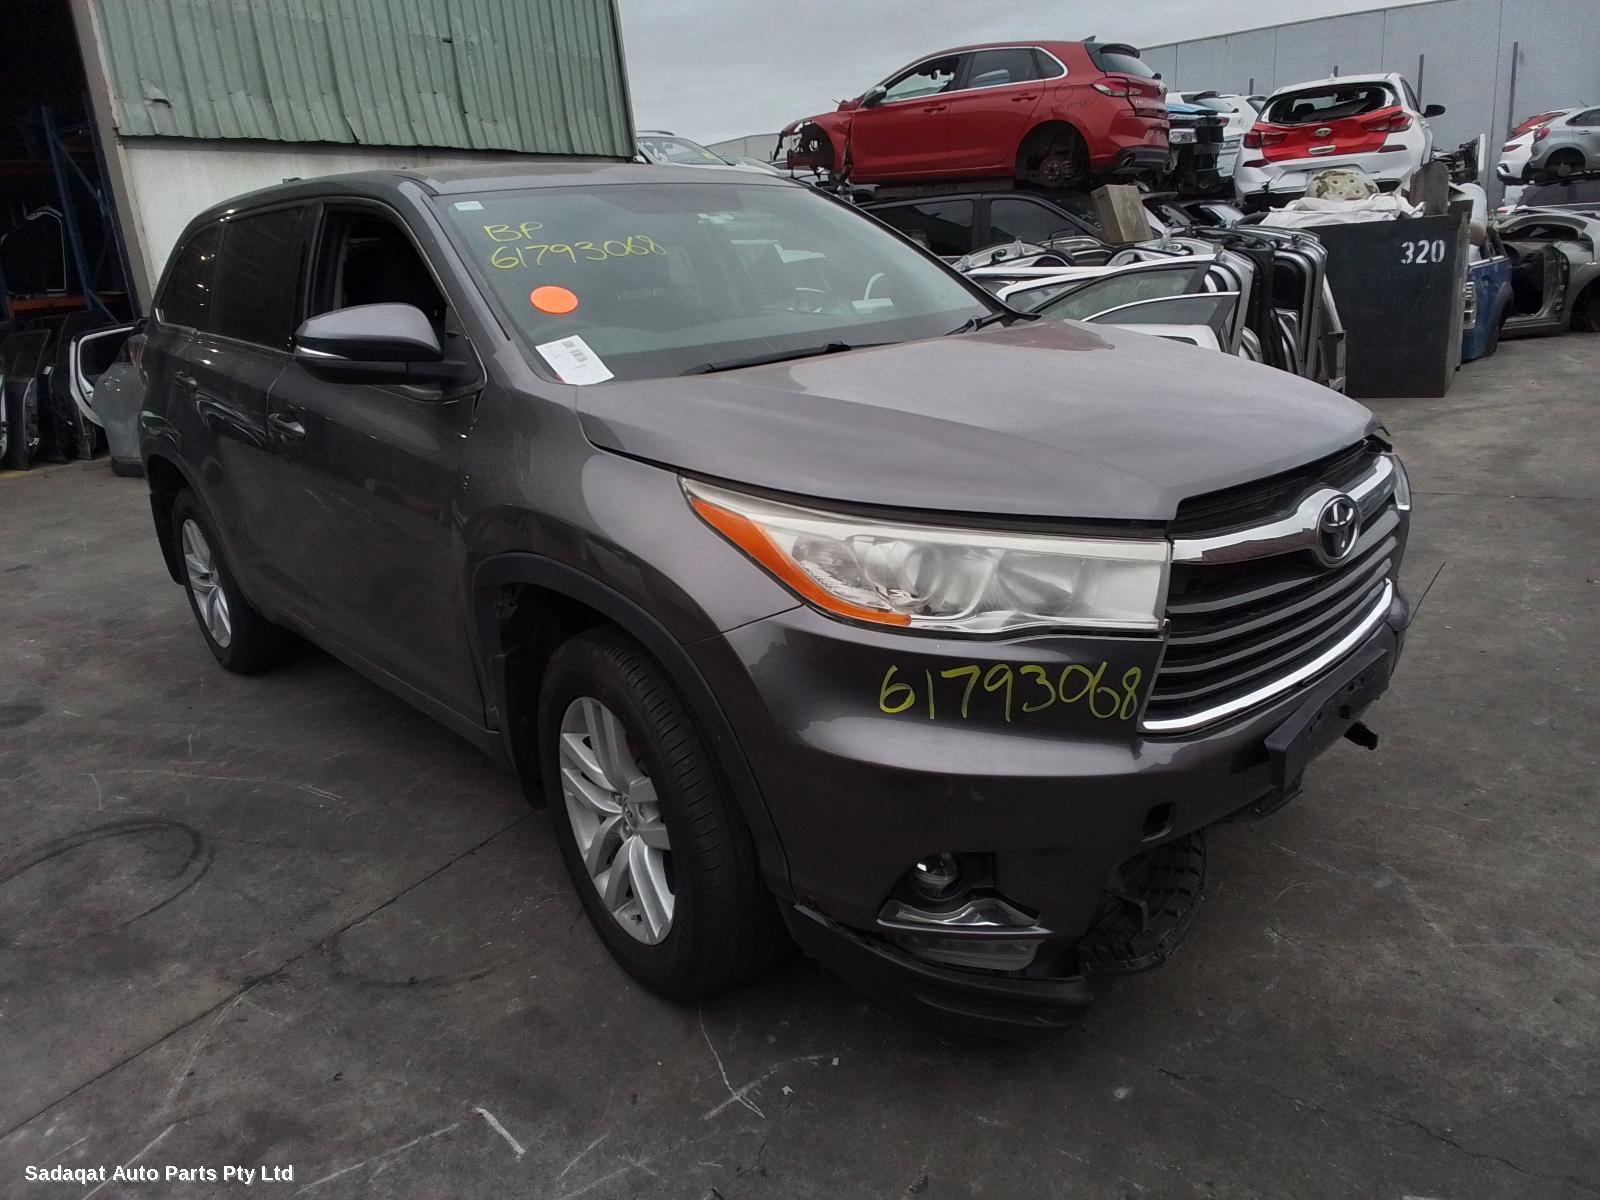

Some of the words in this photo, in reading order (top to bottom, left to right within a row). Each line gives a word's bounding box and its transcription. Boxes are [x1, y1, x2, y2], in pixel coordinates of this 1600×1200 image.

[483, 221, 543, 243] BP
[491, 235, 667, 269] 61793068
[1400, 239, 1445, 264] 320
[879, 661, 1142, 723] 61793068
